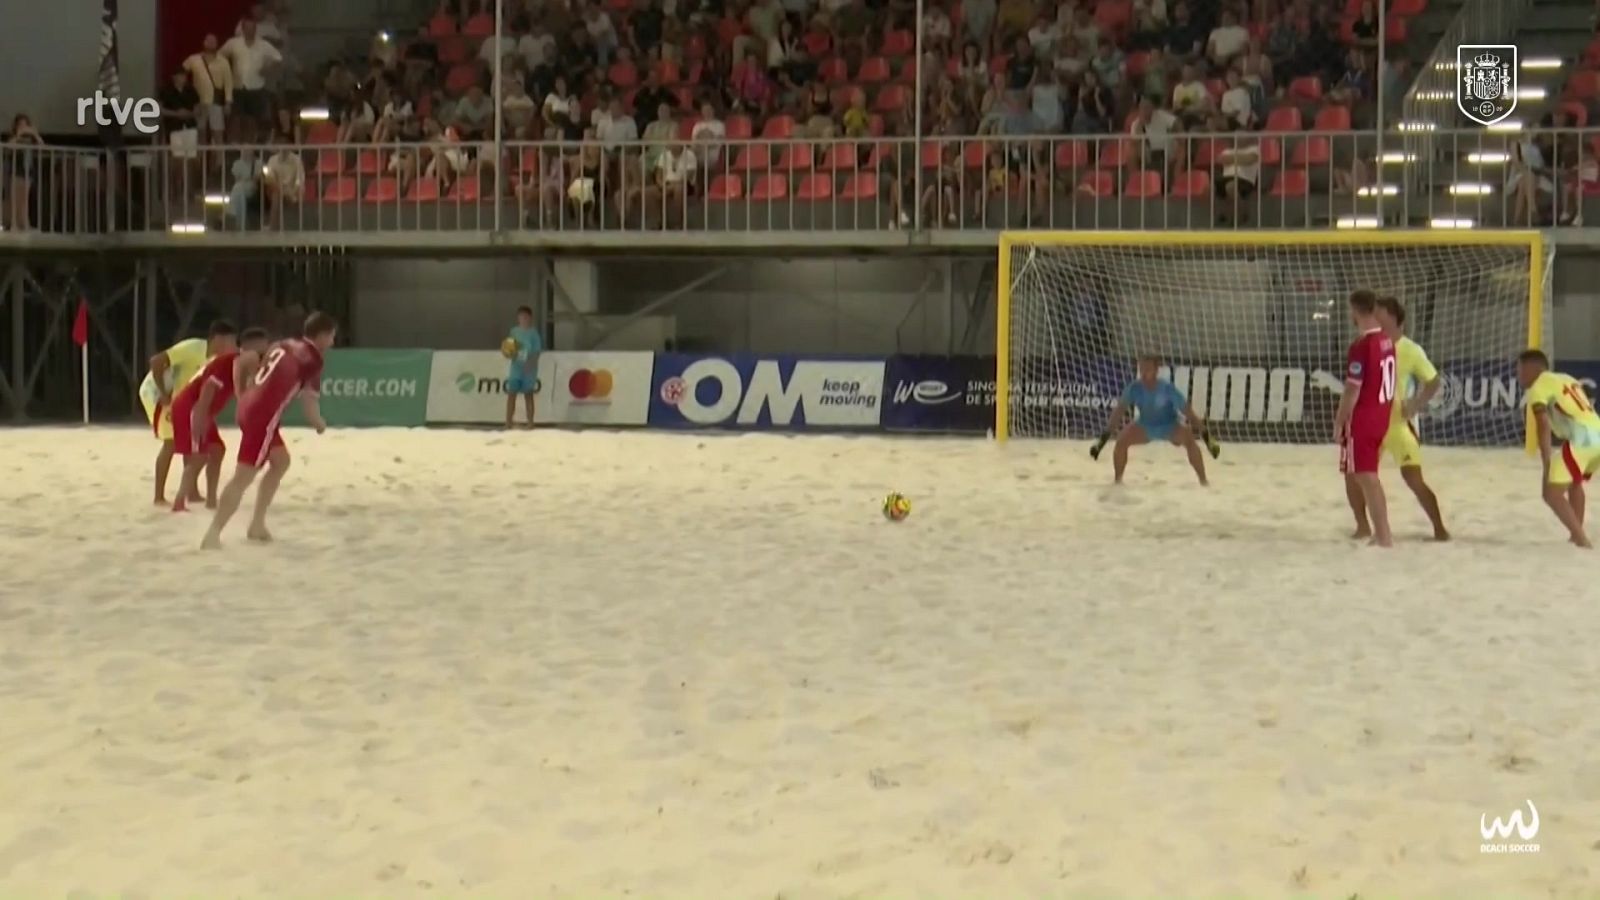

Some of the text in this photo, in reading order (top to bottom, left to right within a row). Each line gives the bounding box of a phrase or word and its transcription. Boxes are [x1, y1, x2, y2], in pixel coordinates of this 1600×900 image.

[822, 378, 860, 396] keep
[1379, 354, 1396, 404] 10
[677, 358, 825, 425] OM
[819, 391, 877, 408] moving
[966, 394, 981, 405] DE
